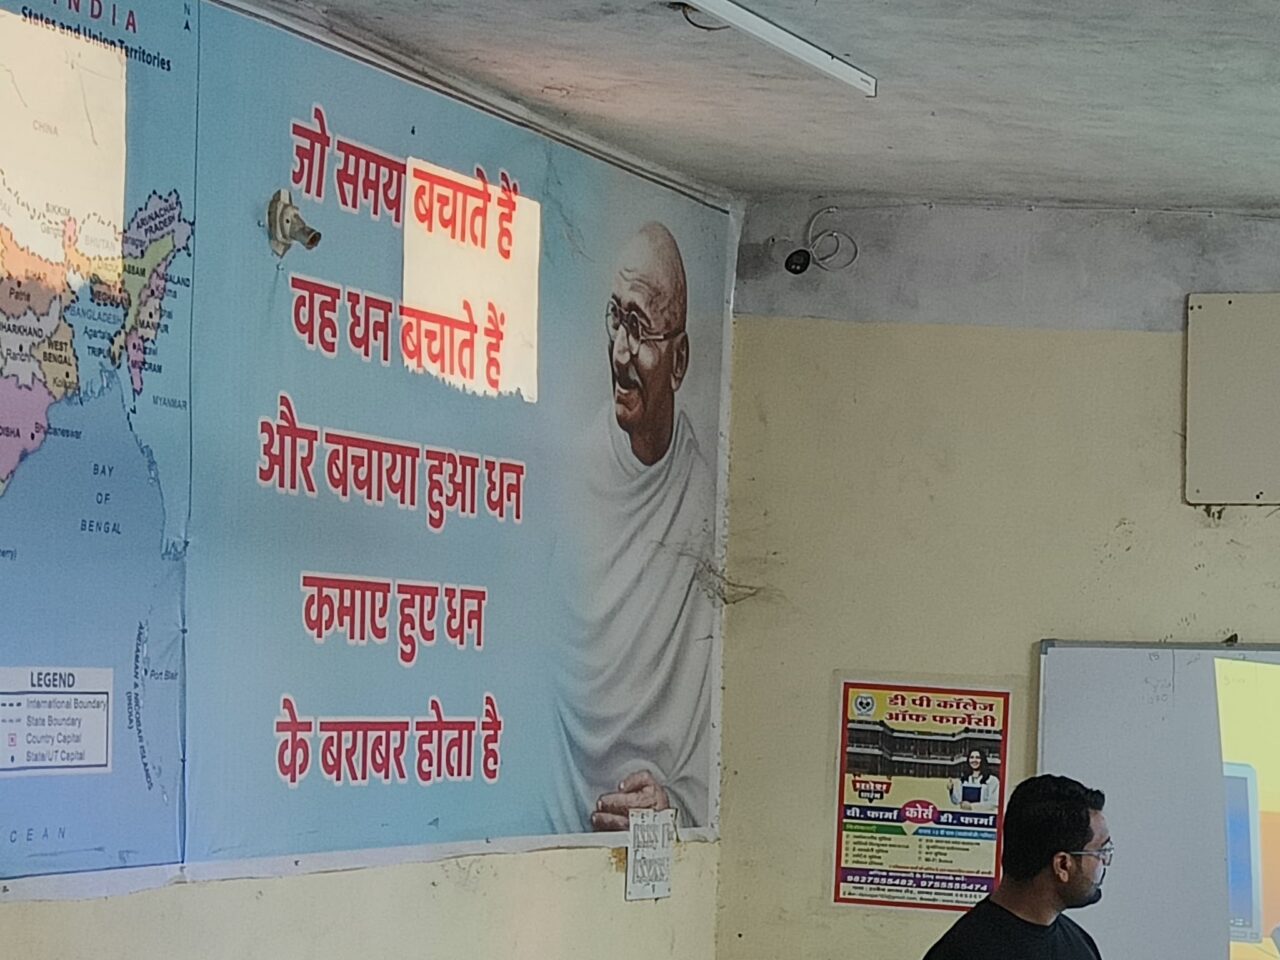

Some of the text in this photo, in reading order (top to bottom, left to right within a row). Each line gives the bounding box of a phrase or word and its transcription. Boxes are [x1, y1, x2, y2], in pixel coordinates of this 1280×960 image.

[52, 0, 137, 33] NDIA
[21, 6, 172, 72] States and Union Territories
[292, 107, 330, 198] जो
[336, 140, 406, 223] समय
[413, 166, 491, 249] बचाते
[0, 322, 44, 339] HARKHAND
[291, 276, 506, 389] वह धन बचाते हैं
[48, 340, 69, 353] WEST
[43, 351, 73, 367] BENGAL
[92, 463, 115, 478] BAY
[258, 395, 524, 529] और बचाया हुआ धन
[95, 492, 111, 505] OF
[80, 519, 122, 535] BENGAL
[302, 575, 486, 663] कमाए हुए धन
[30, 671, 76, 688] LEGEND
[888, 694, 906, 707] डी
[911, 695, 931, 708] पी
[276, 695, 502, 783] के बराबर होता है
[905, 803, 933, 820] कोर्स
[9, 826, 66, 843] CEAN
